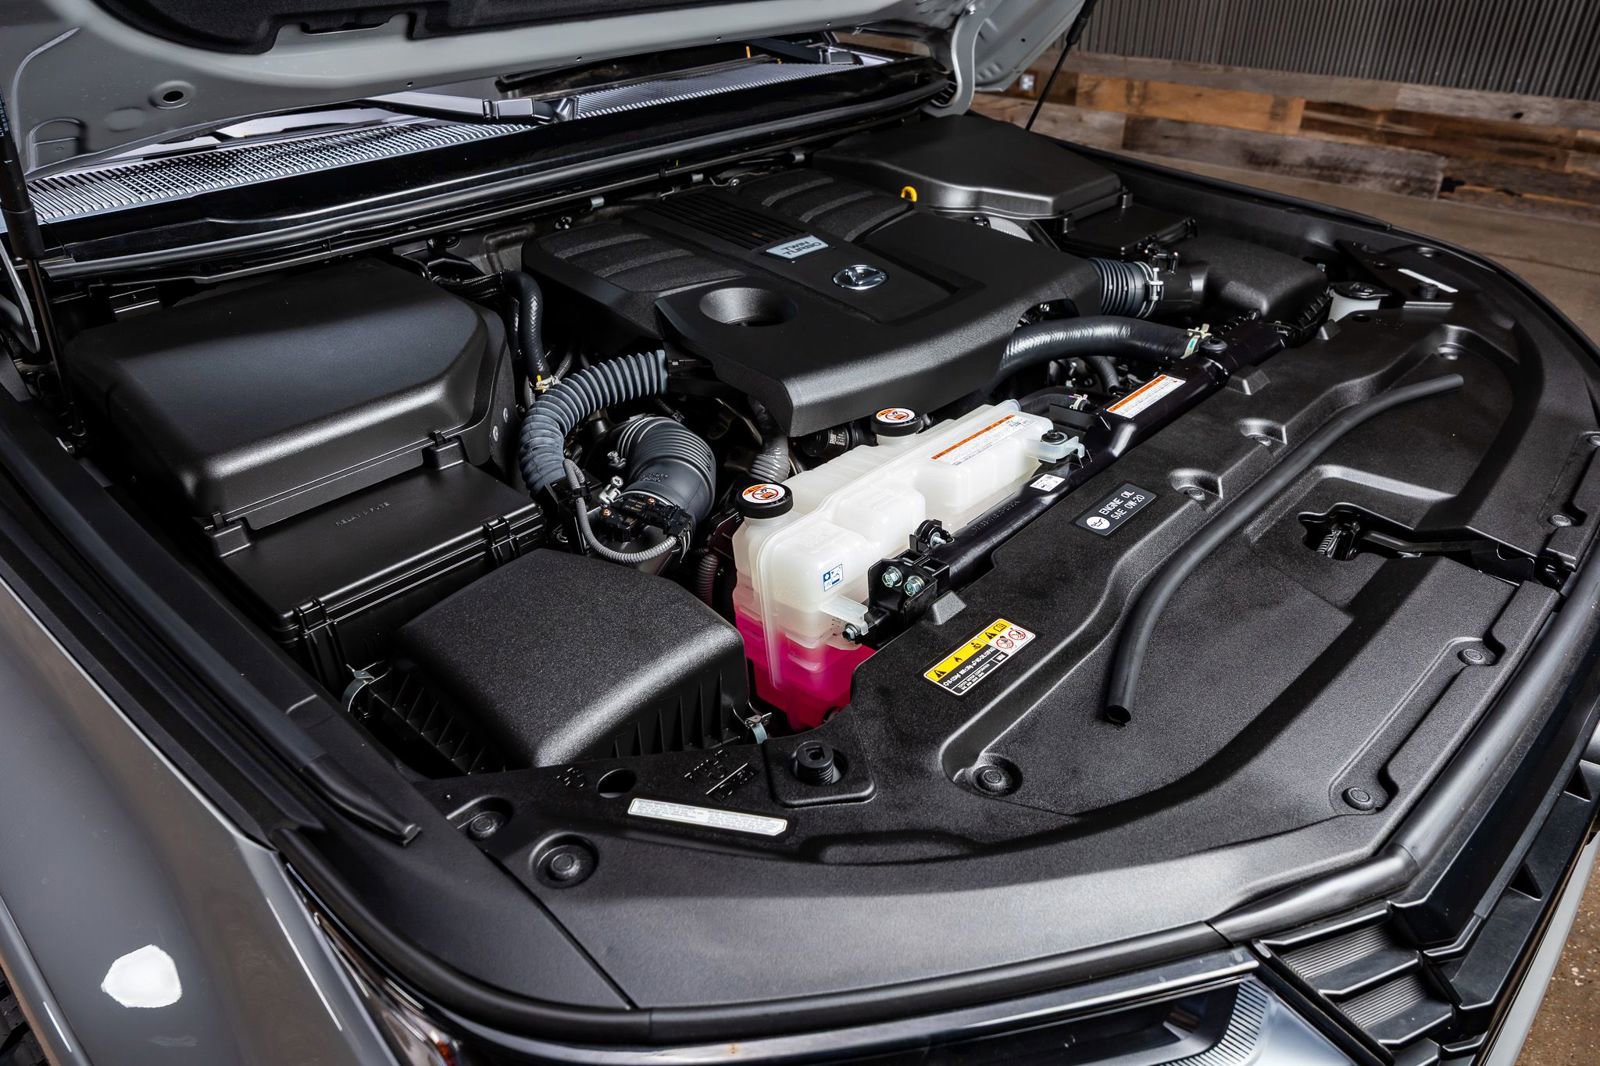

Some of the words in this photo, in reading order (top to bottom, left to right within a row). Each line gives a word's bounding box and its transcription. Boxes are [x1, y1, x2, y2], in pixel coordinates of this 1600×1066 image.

[781, 241, 810, 251] TWIN
[783, 242, 822, 256] TURBO
[1098, 497, 1124, 516] ENGINE
[1110, 509, 1128, 520] SAE
[1124, 494, 1145, 509] 0W-20
